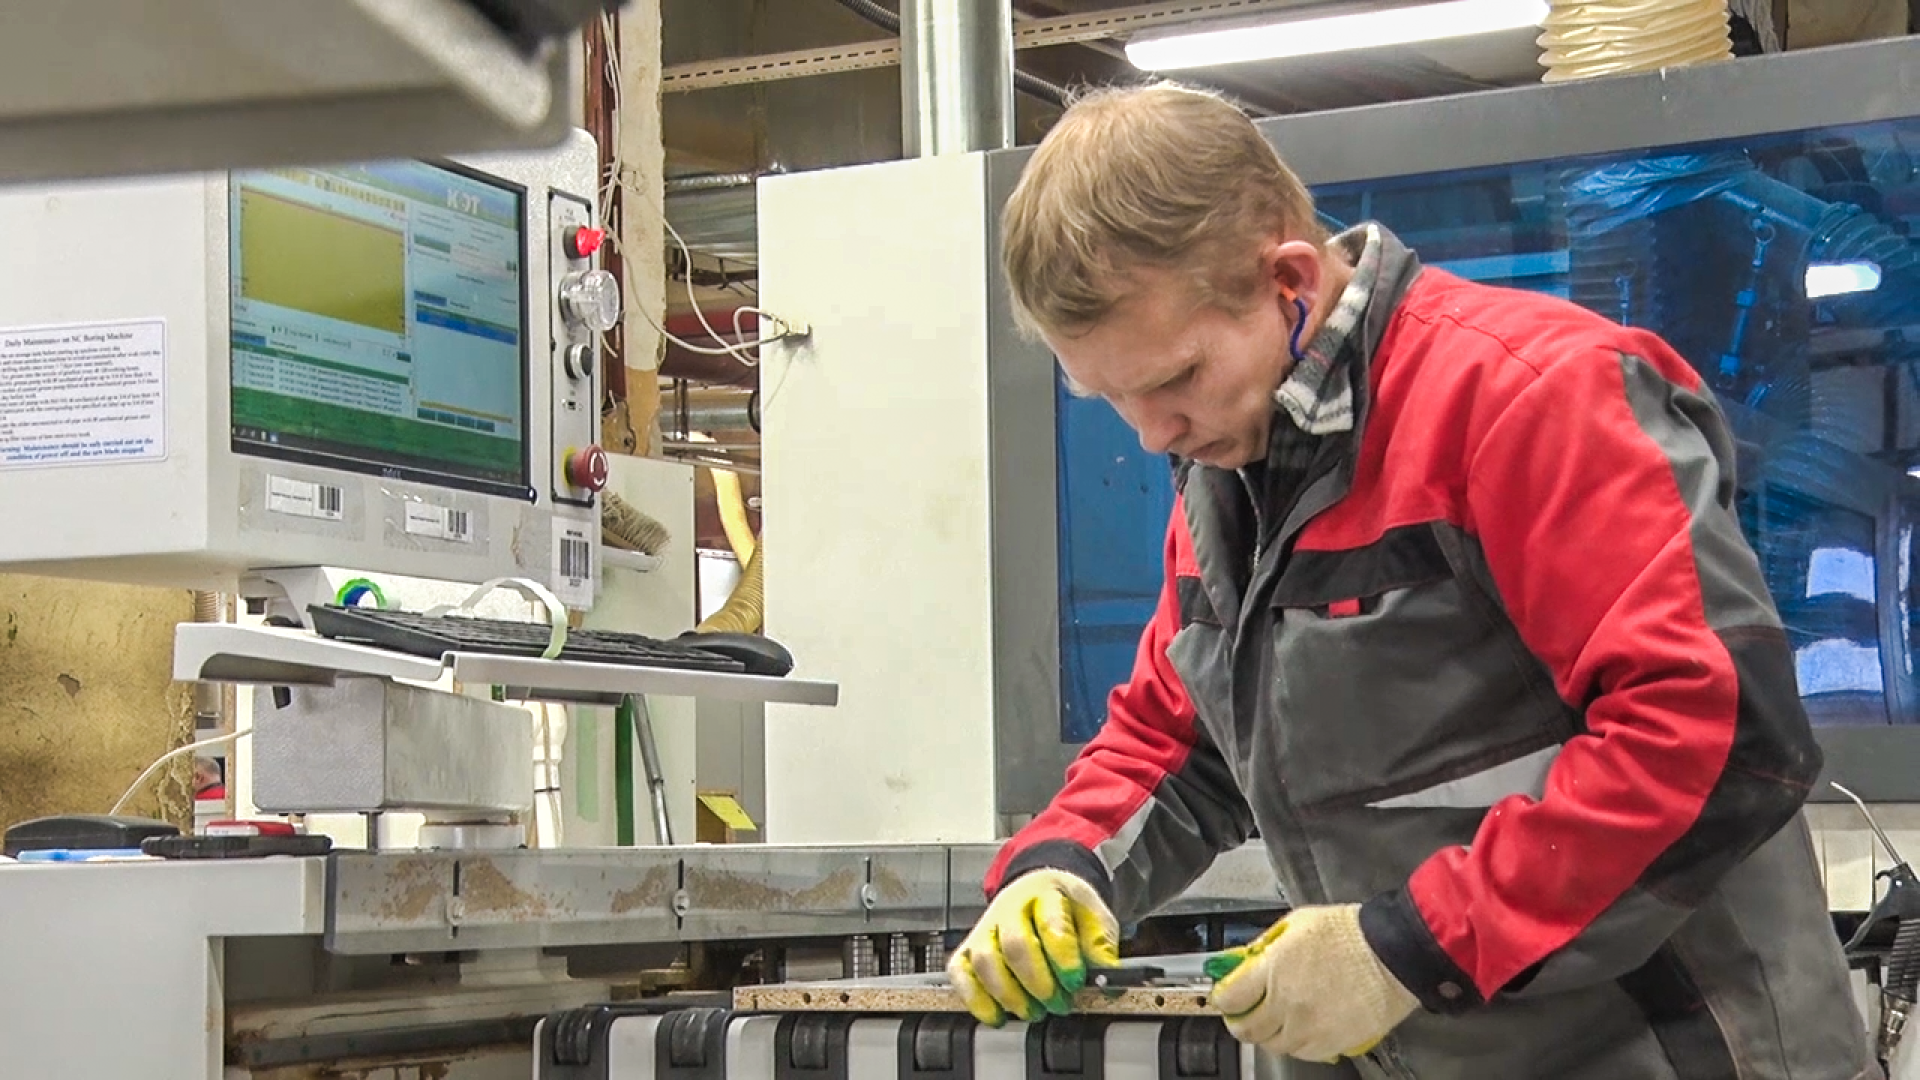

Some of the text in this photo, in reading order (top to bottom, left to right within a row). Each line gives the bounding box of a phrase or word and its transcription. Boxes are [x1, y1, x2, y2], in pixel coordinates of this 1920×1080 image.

[5, 338, 21, 348] Daily
[23, 337, 60, 346] Maintenance
[106, 331, 133, 340] Machine
